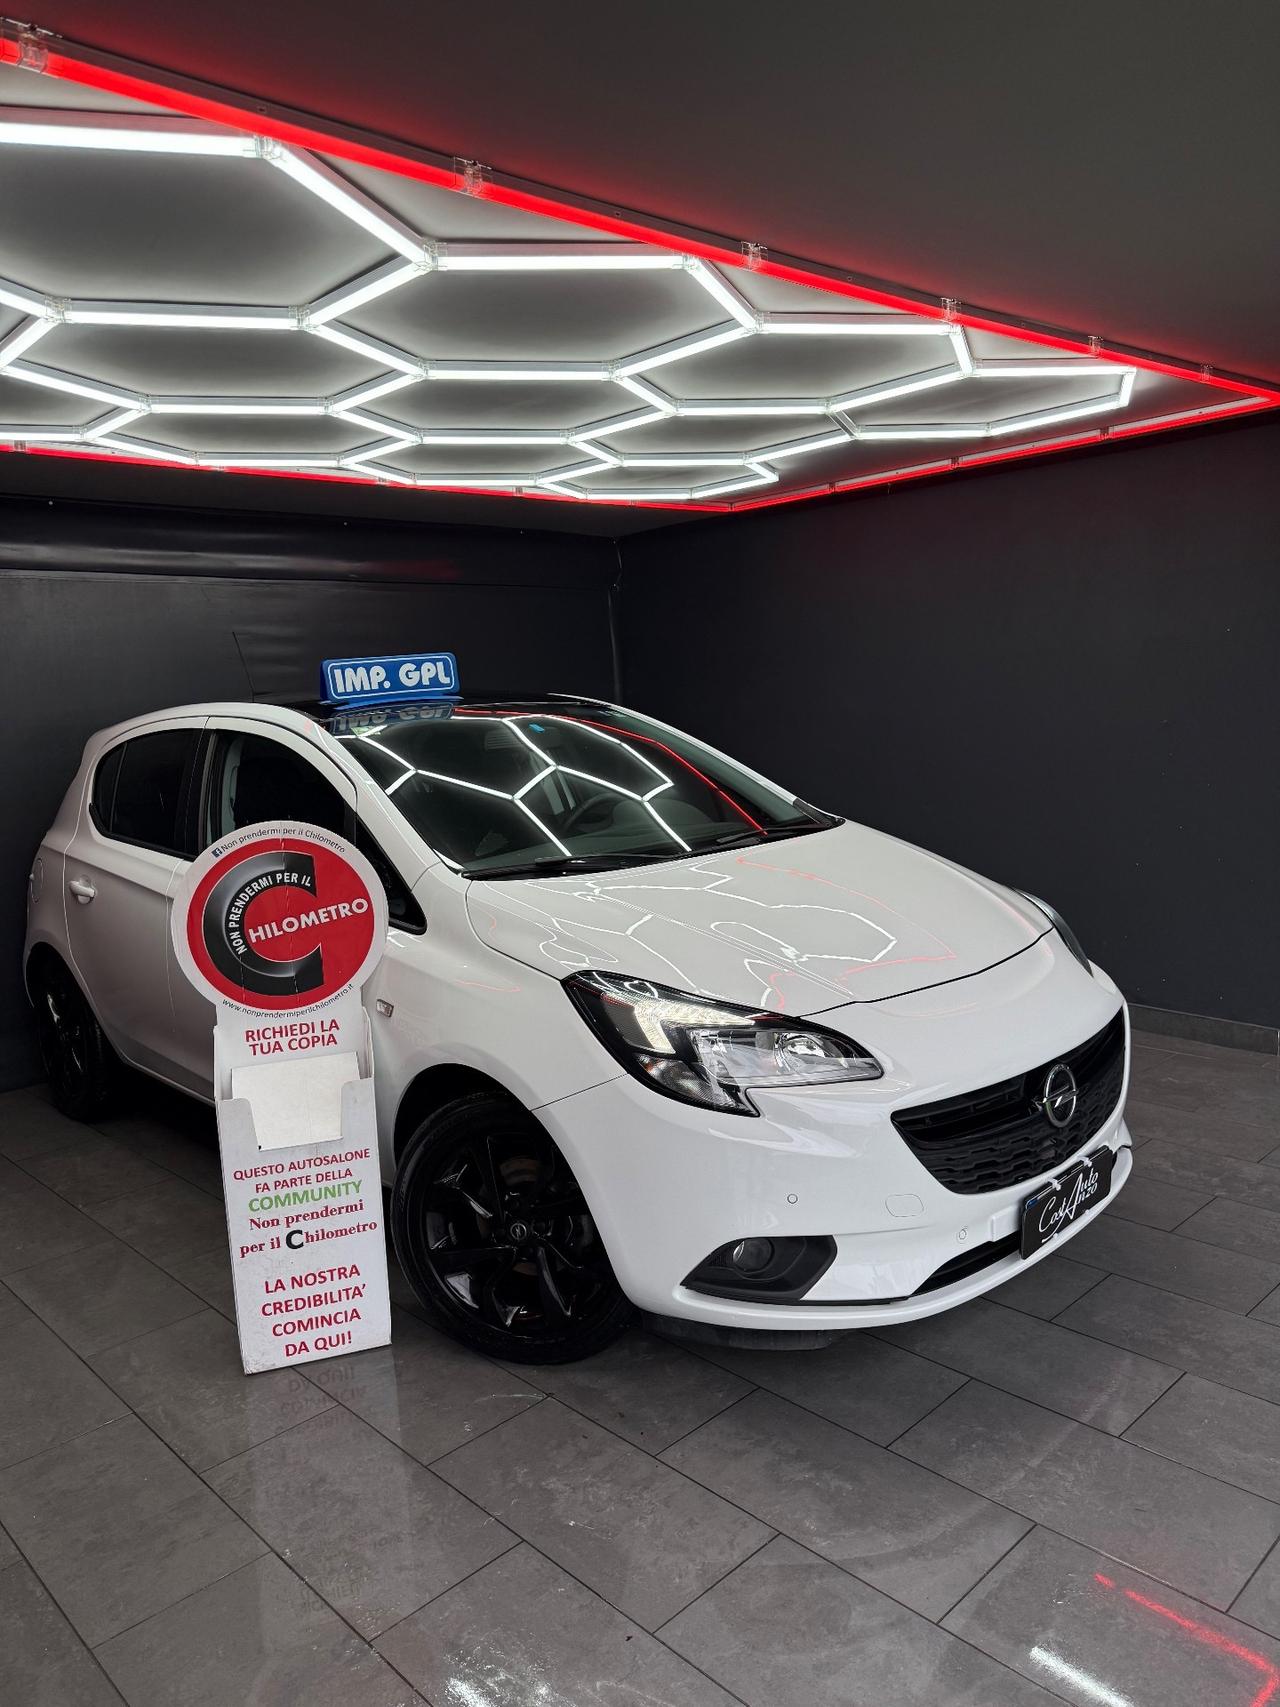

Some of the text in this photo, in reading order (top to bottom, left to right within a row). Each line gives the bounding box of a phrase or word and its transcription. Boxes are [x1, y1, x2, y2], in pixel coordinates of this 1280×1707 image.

[334, 661, 450, 693] IMP. GPL
[221, 839, 238, 852] Non
[239, 828, 281, 844] prendermi
[283, 828, 296, 837] per
[305, 829, 345, 853] Chilometro
[226, 872, 312, 955] NON PRENDERMI PER IL
[245, 1019, 340, 1042] RICHIEDI LA
[249, 1034, 338, 1056] TUA COPIA
[233, 1148, 371, 1181] QUESTO AUTOSALONE
[248, 1180, 363, 1212] COMMUNITY
[255, 1168, 353, 1194] FA PARTE DELLA
[249, 1199, 365, 1231] Non prendermi
[239, 1221, 378, 1259] per il Chilometro
[264, 1264, 361, 1294] LA NOSTRA
[272, 1308, 362, 1337] COMINCIA
[285, 1331, 352, 1357] DA QUI!
